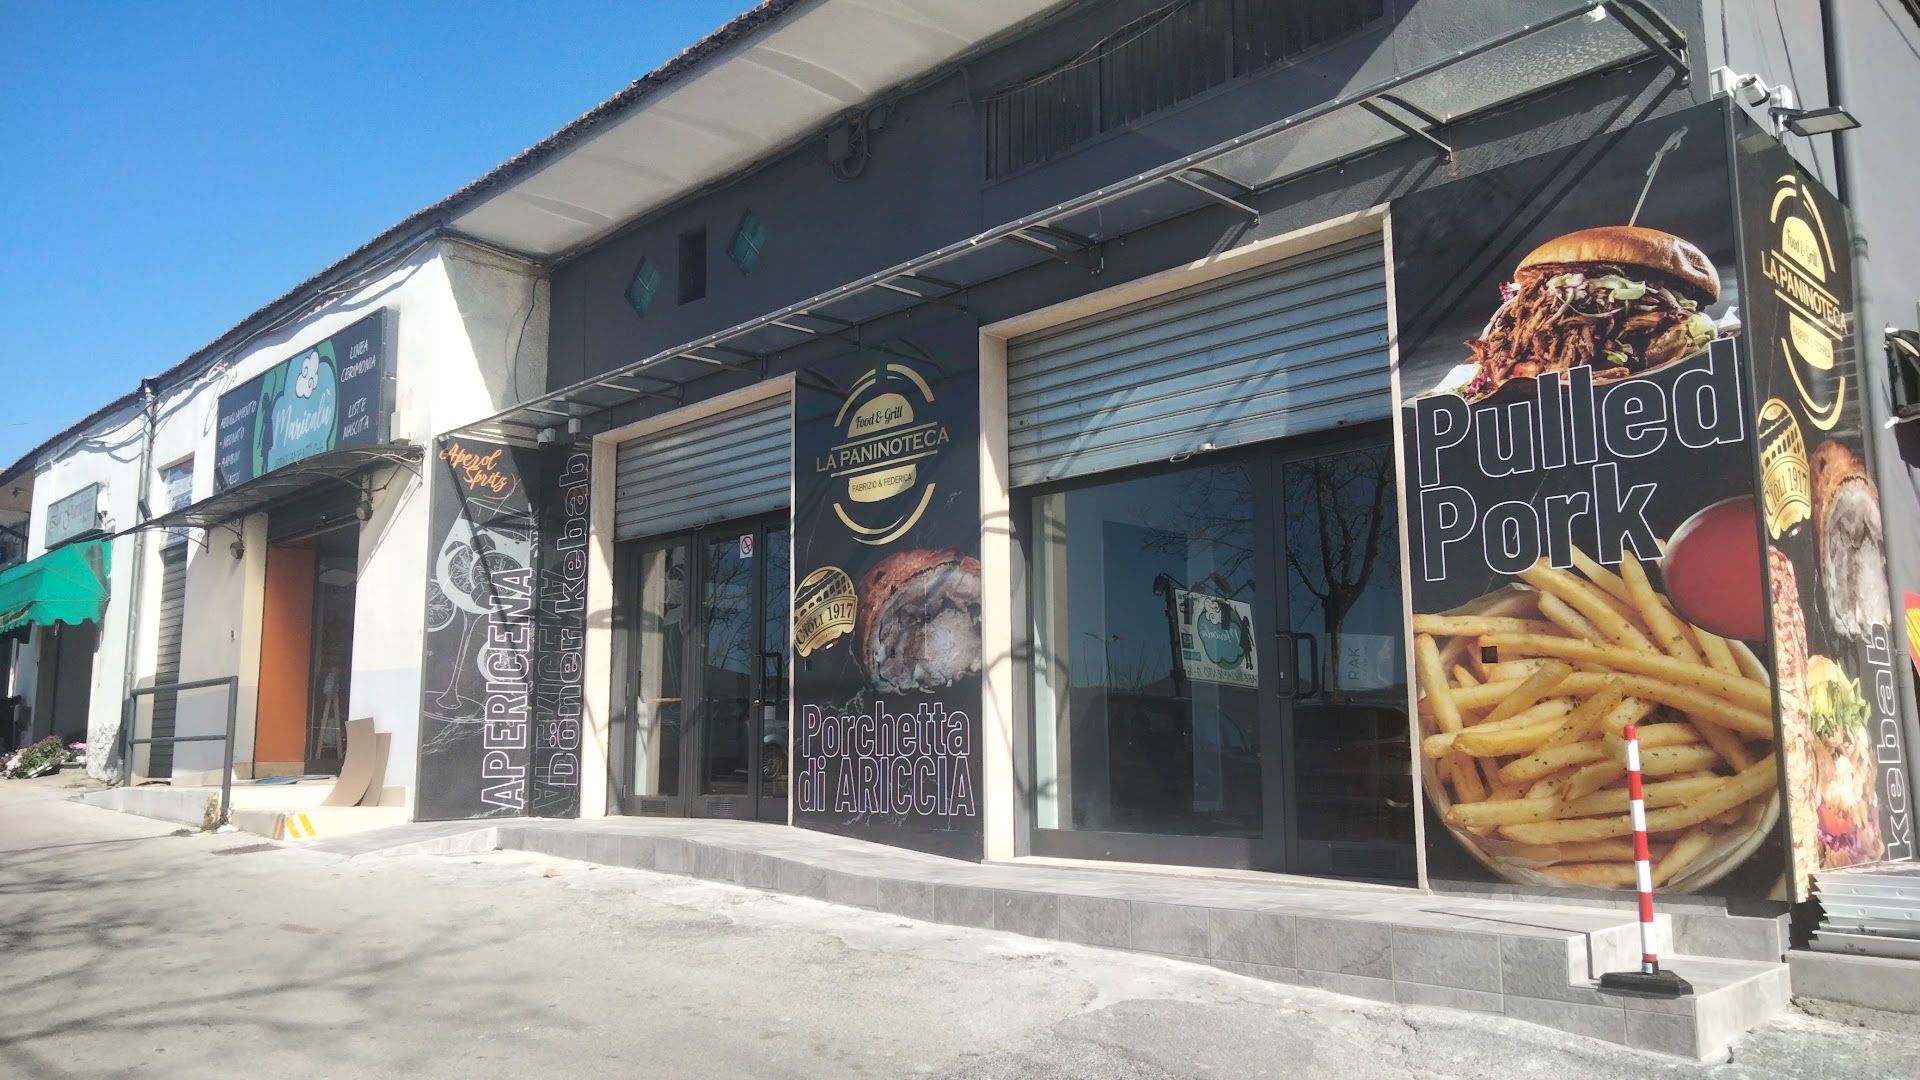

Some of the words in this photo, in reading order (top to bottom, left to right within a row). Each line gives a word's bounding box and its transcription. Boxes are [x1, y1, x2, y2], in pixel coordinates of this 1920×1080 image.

[1761, 250, 1779, 284] LA
[1779, 265, 1848, 334] PANINOTECA
[350, 339, 368, 360] LINEA
[341, 355, 376, 382] CERIMONIA
[348, 397, 367, 418] LISTE
[856, 413, 874, 429] Food
[876, 411, 883, 423] &
[885, 406, 902, 424] Grill
[1416, 337, 1744, 488] Pulled
[342, 415, 369, 440] NASCITA
[439, 443, 502, 470] Aperol
[816, 454, 837, 472] LA
[841, 427, 950, 466] PANINOTECA
[463, 465, 507, 492] Spritz
[852, 481, 877, 493] FABRIZIO
[878, 479, 883, 487] &
[884, 473, 913, 486] FEDERICA
[1787, 467, 1808, 496] 1917
[555, 453, 589, 613] kebab
[1420, 462, 1665, 581] Pork
[827, 603, 853, 621] 1917
[1348, 647, 1360, 680] RAK
[481, 567, 532, 809] APERICENA
[548, 629, 583, 786] Döner
[802, 701, 970, 757] Porchetta
[1867, 621, 1913, 862] kebab
[798, 755, 826, 812] di
[835, 756, 975, 816] ARICCIA
